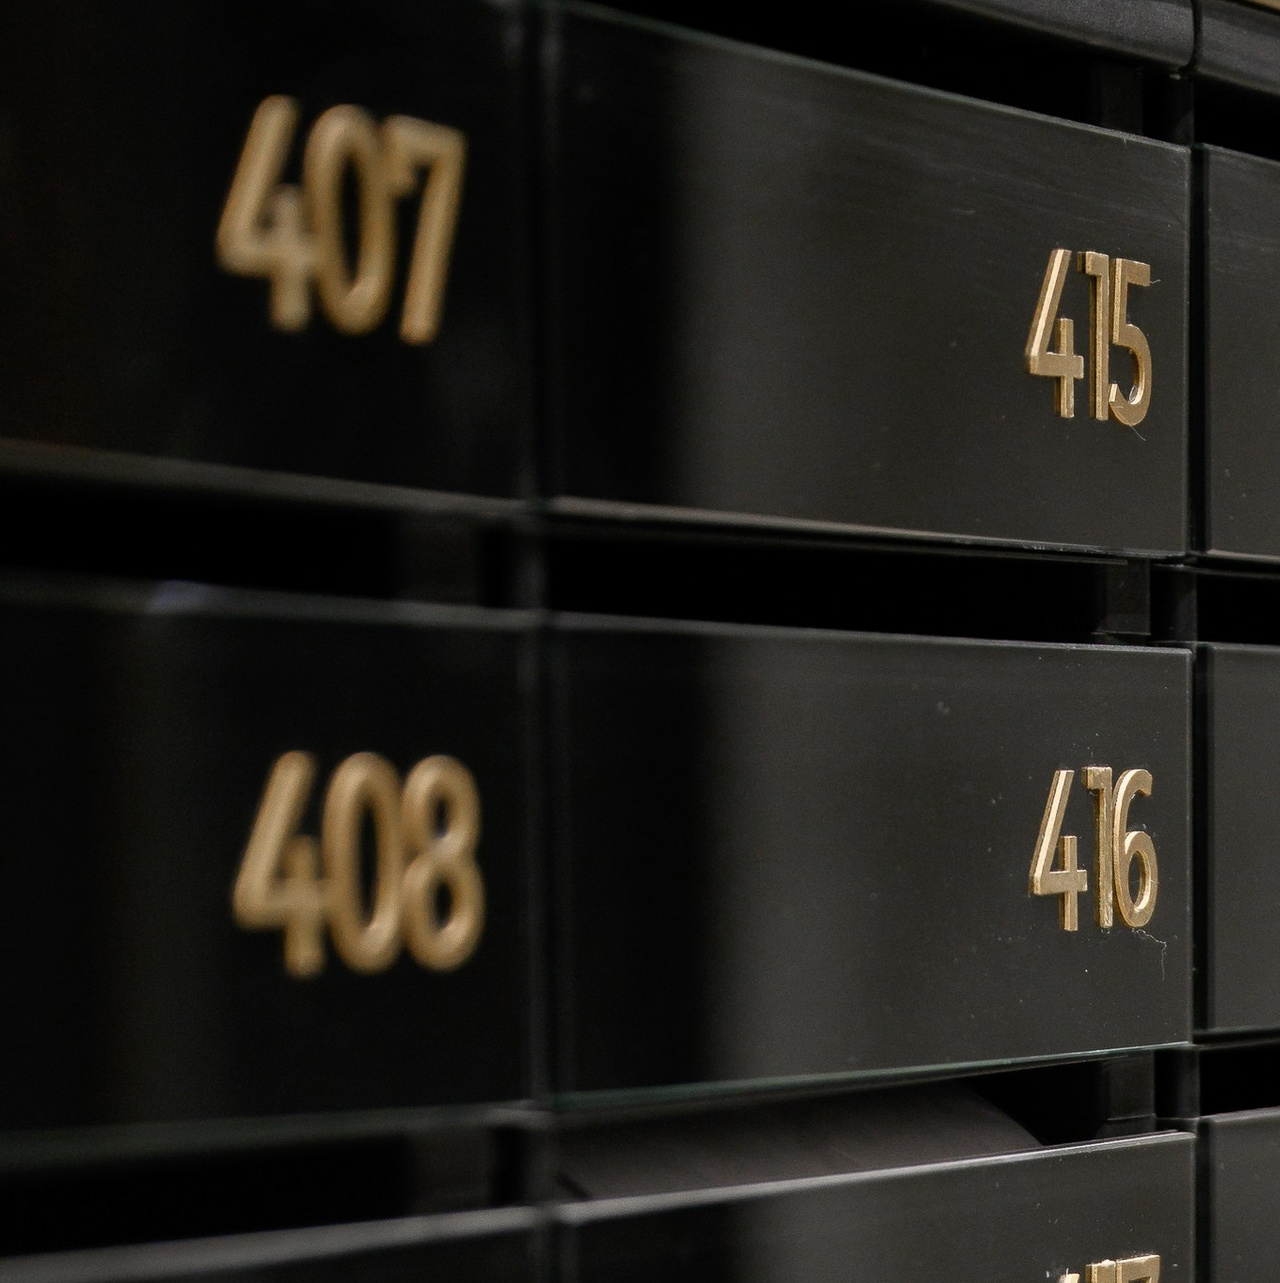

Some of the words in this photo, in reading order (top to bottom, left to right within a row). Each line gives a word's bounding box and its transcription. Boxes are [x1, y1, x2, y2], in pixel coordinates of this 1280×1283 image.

[218, 97, 466, 345] 407
[1025, 249, 1152, 426] 415
[233, 750, 484, 976] 408
[1029, 767, 1158, 931] 416
